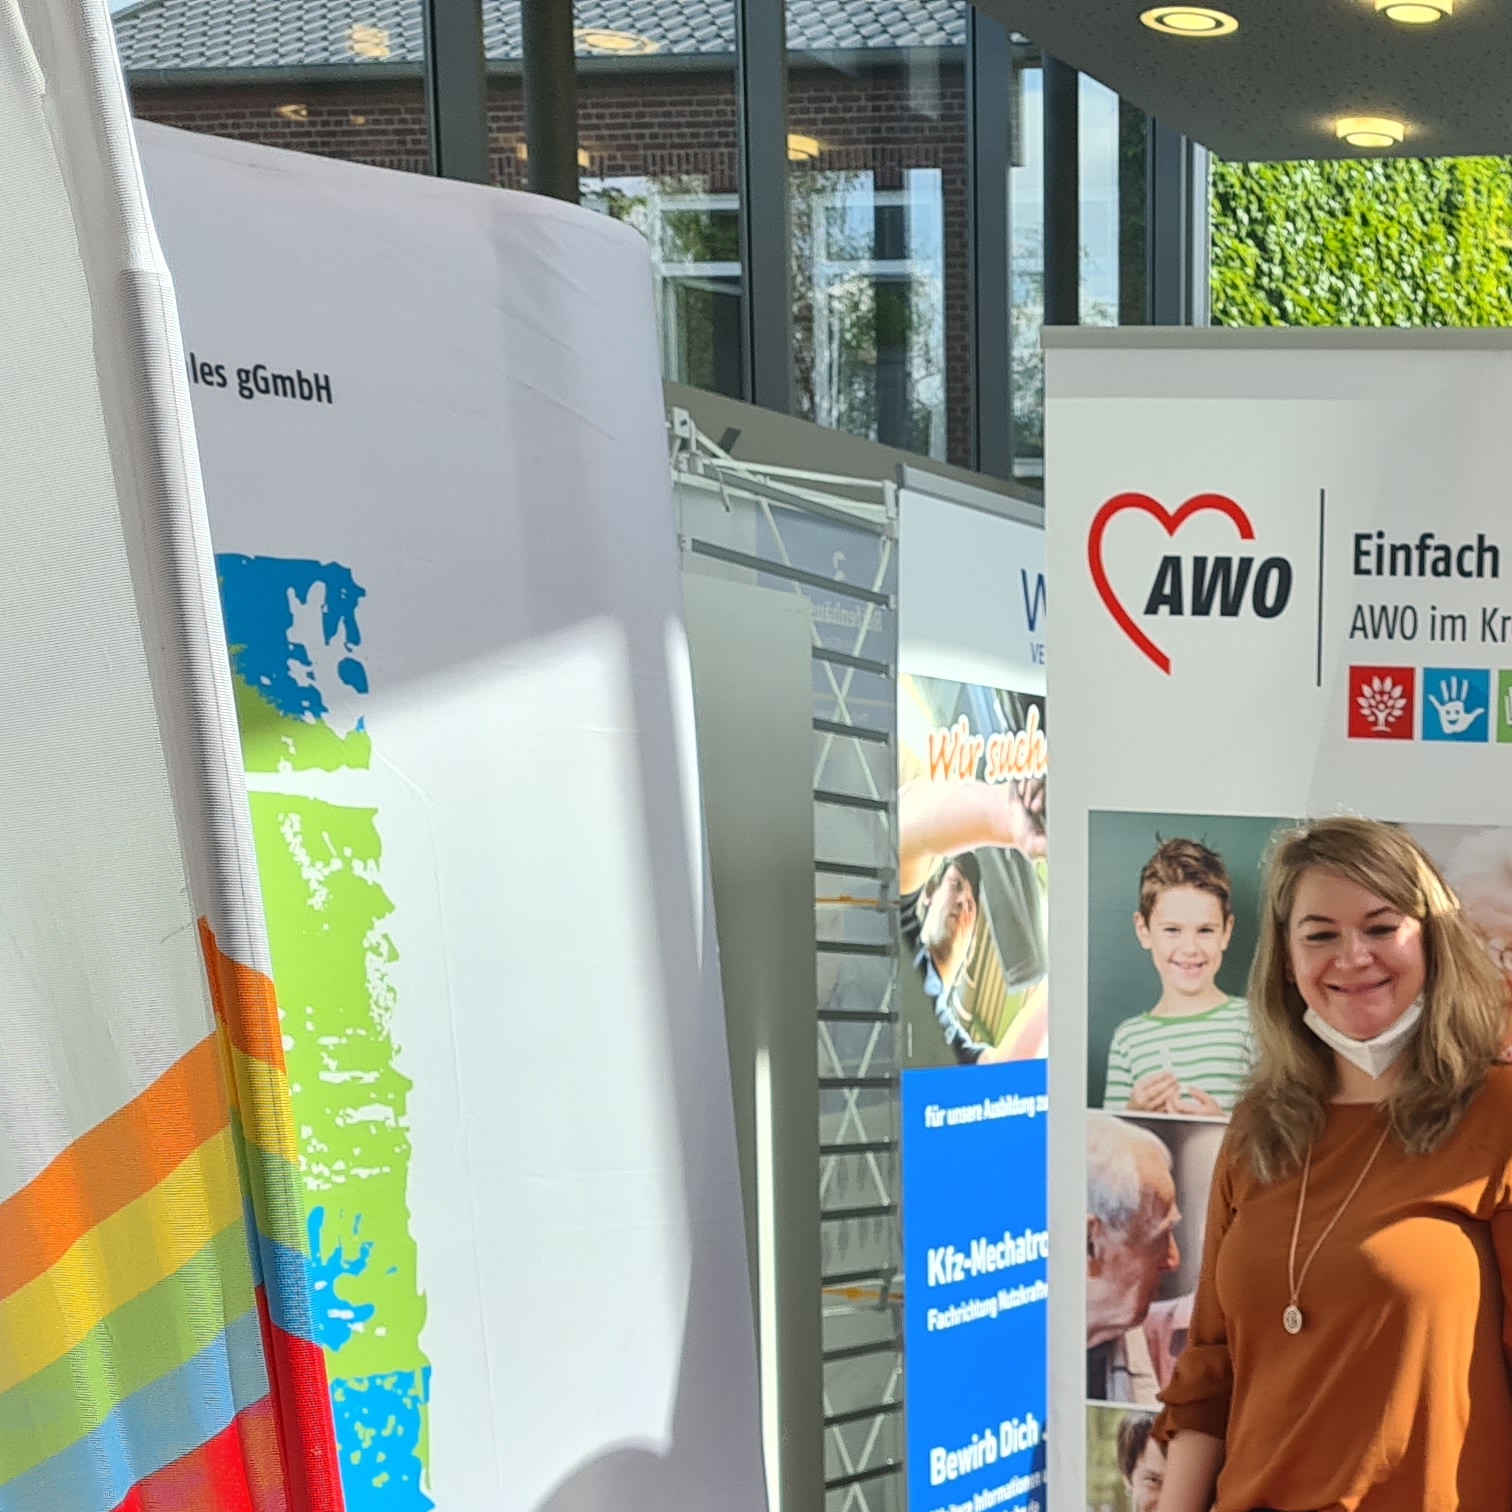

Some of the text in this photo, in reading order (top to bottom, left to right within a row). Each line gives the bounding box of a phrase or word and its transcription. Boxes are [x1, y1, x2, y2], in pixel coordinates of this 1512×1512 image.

[189, 352, 333, 404] les gGmbH
[1352, 532, 1500, 580] Einfach
[1144, 555, 1293, 618] AWO
[1348, 604, 1419, 641] AWO
[1429, 605, 1468, 643] im
[928, 705, 1048, 787] Wir such
[927, 1227, 1048, 1287] Kfz-Mechatro
[997, 1279, 1048, 1312] Nutzkraft
[930, 1412, 1039, 1486] Bewirb Dich
